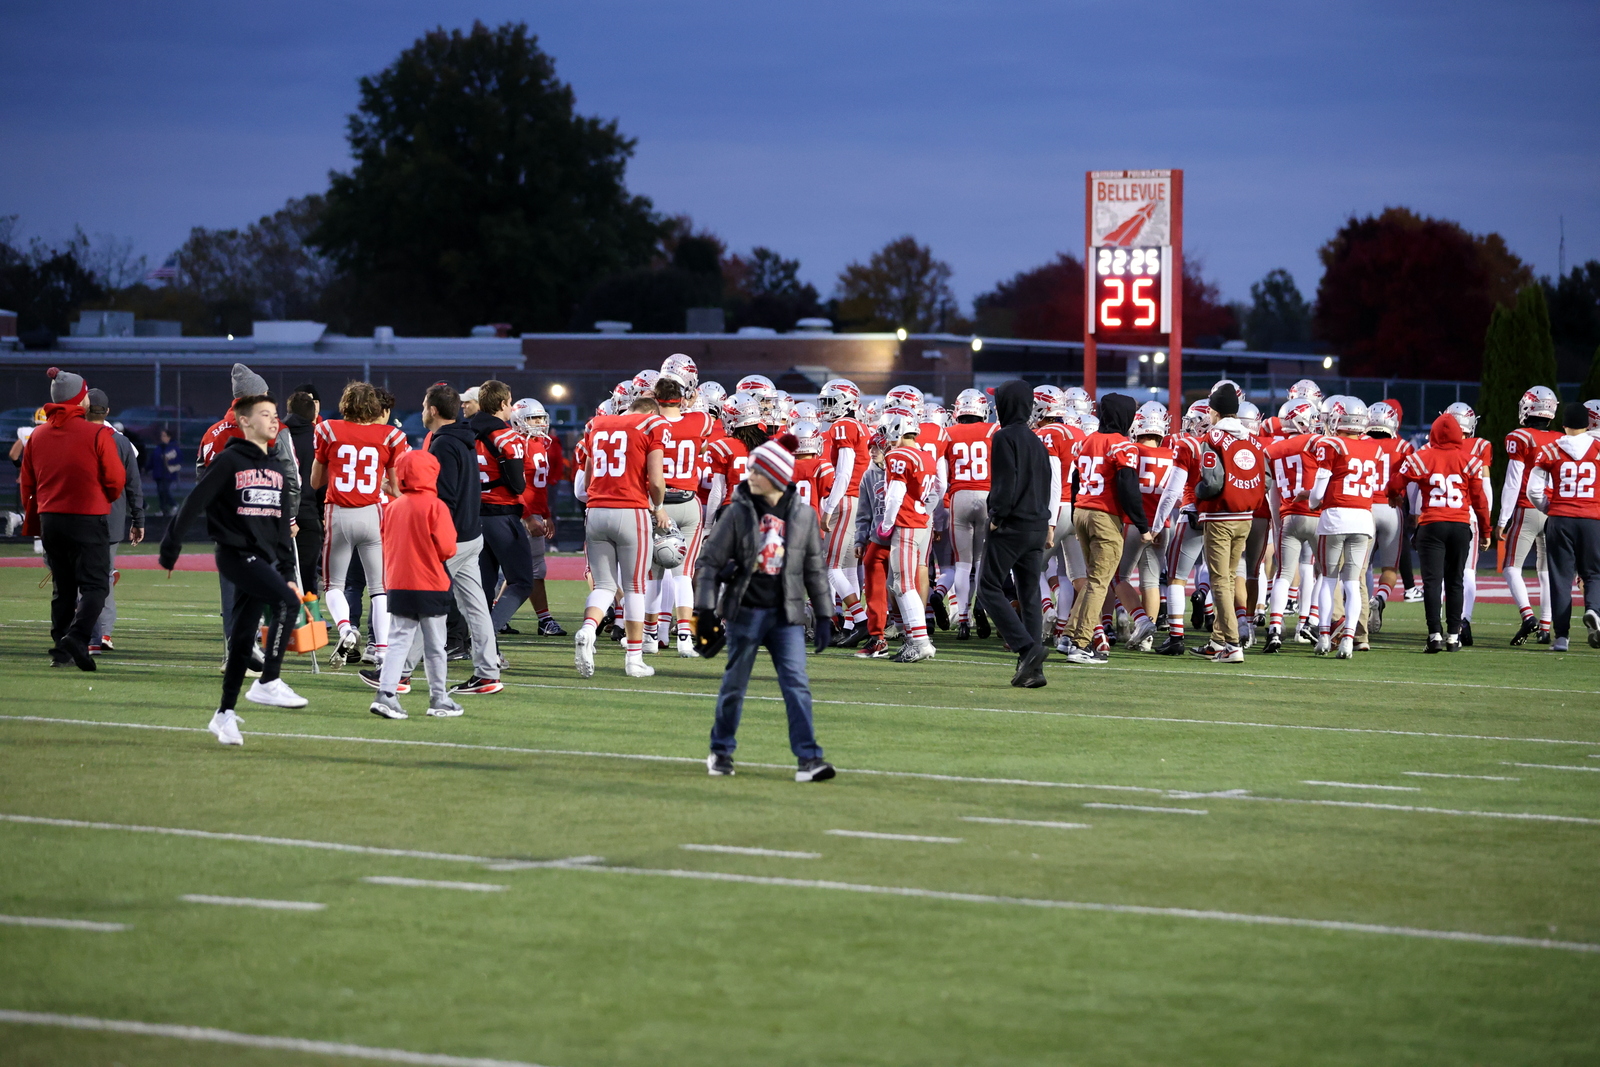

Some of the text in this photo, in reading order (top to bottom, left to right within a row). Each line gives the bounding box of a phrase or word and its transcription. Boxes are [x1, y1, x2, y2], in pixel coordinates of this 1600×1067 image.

[1097, 181, 1166, 201] BELLEVUE
[1097, 249, 1160, 275] 22:25
[1101, 279, 1155, 326] 25
[834, 425, 847, 440] 11
[1506, 440, 1517, 454] 18
[335, 444, 379, 494] 33
[512, 443, 524, 459] 16
[593, 431, 628, 477] 63
[889, 459, 906, 474] 38
[952, 441, 988, 480] 28
[1139, 456, 1174, 495] 57
[1228, 472, 1261, 489] VARSITY
[1274, 454, 1305, 499] 47
[1343, 458, 1377, 498] 23
[1429, 473, 1464, 508] 26
[1559, 461, 1597, 498] 82
